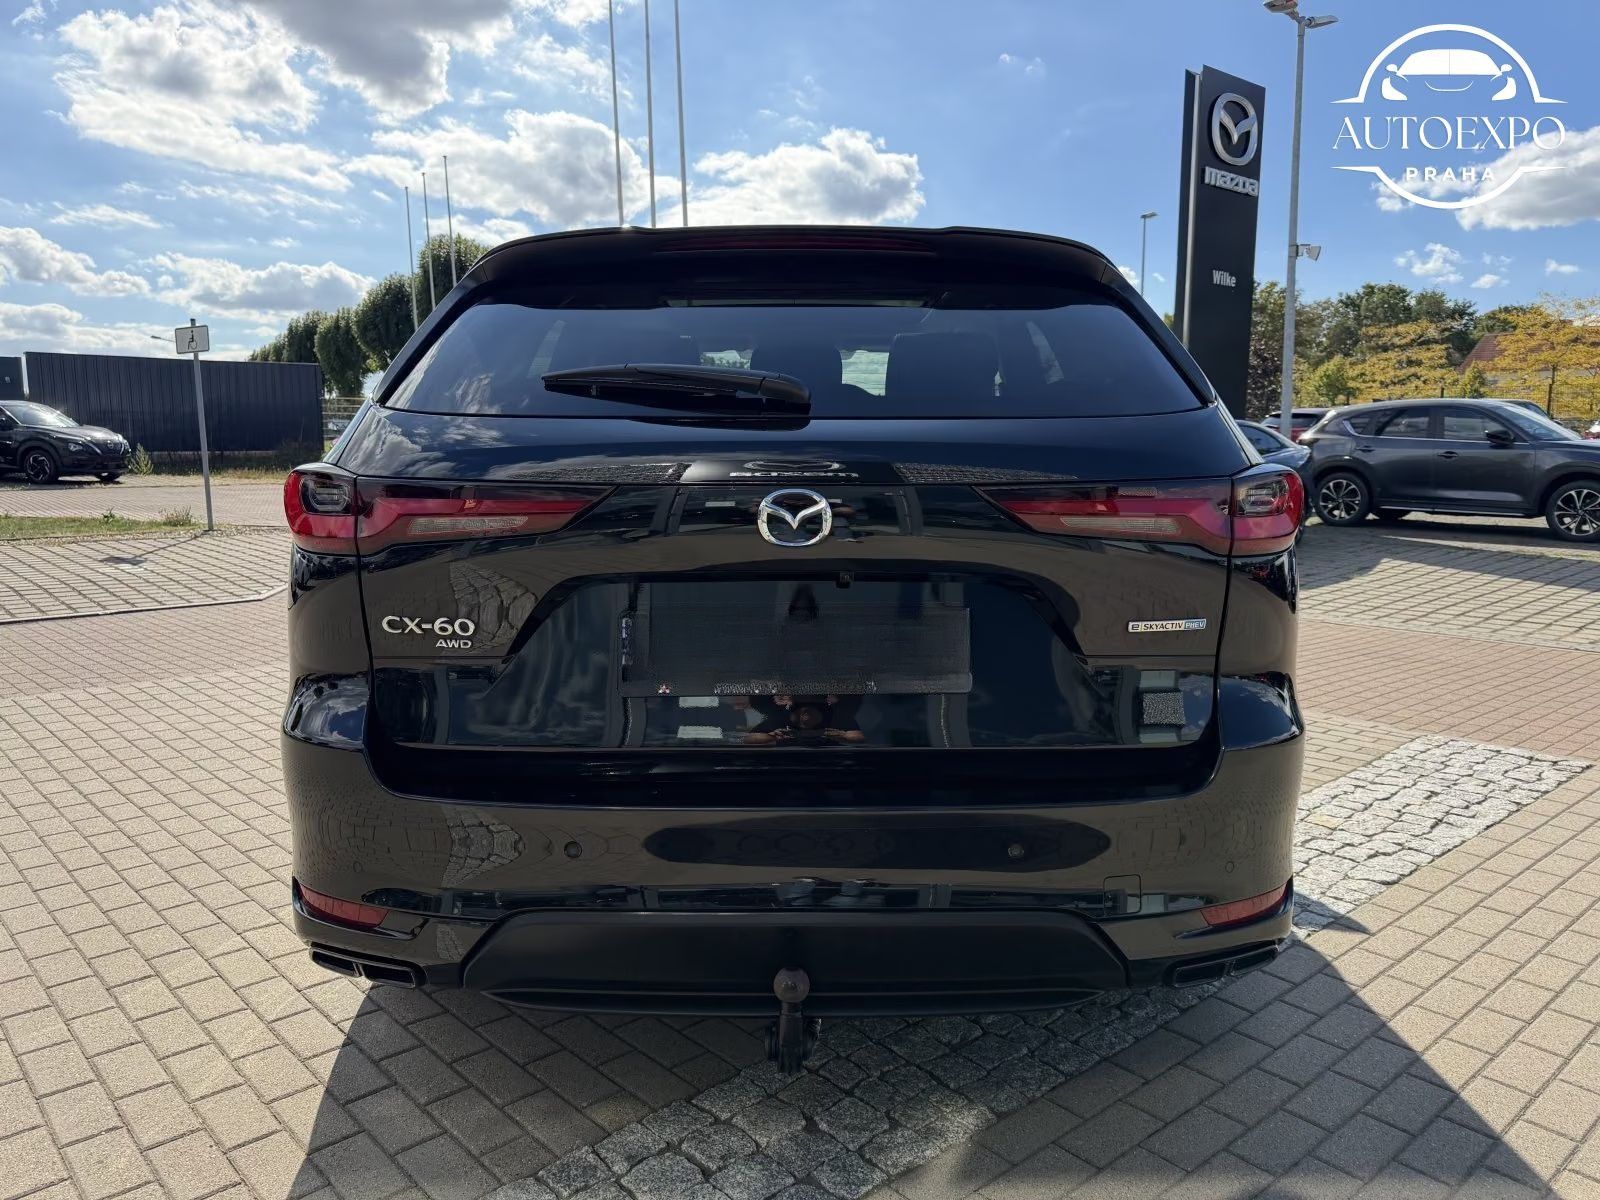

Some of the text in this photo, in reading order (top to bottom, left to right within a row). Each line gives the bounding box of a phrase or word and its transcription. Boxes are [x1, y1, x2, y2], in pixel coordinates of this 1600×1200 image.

[1212, 269, 1237, 287] Wilke
[381, 615, 476, 636] CX-60
[1143, 622, 1184, 631] SKYACTIV
[435, 639, 472, 649] AWD
